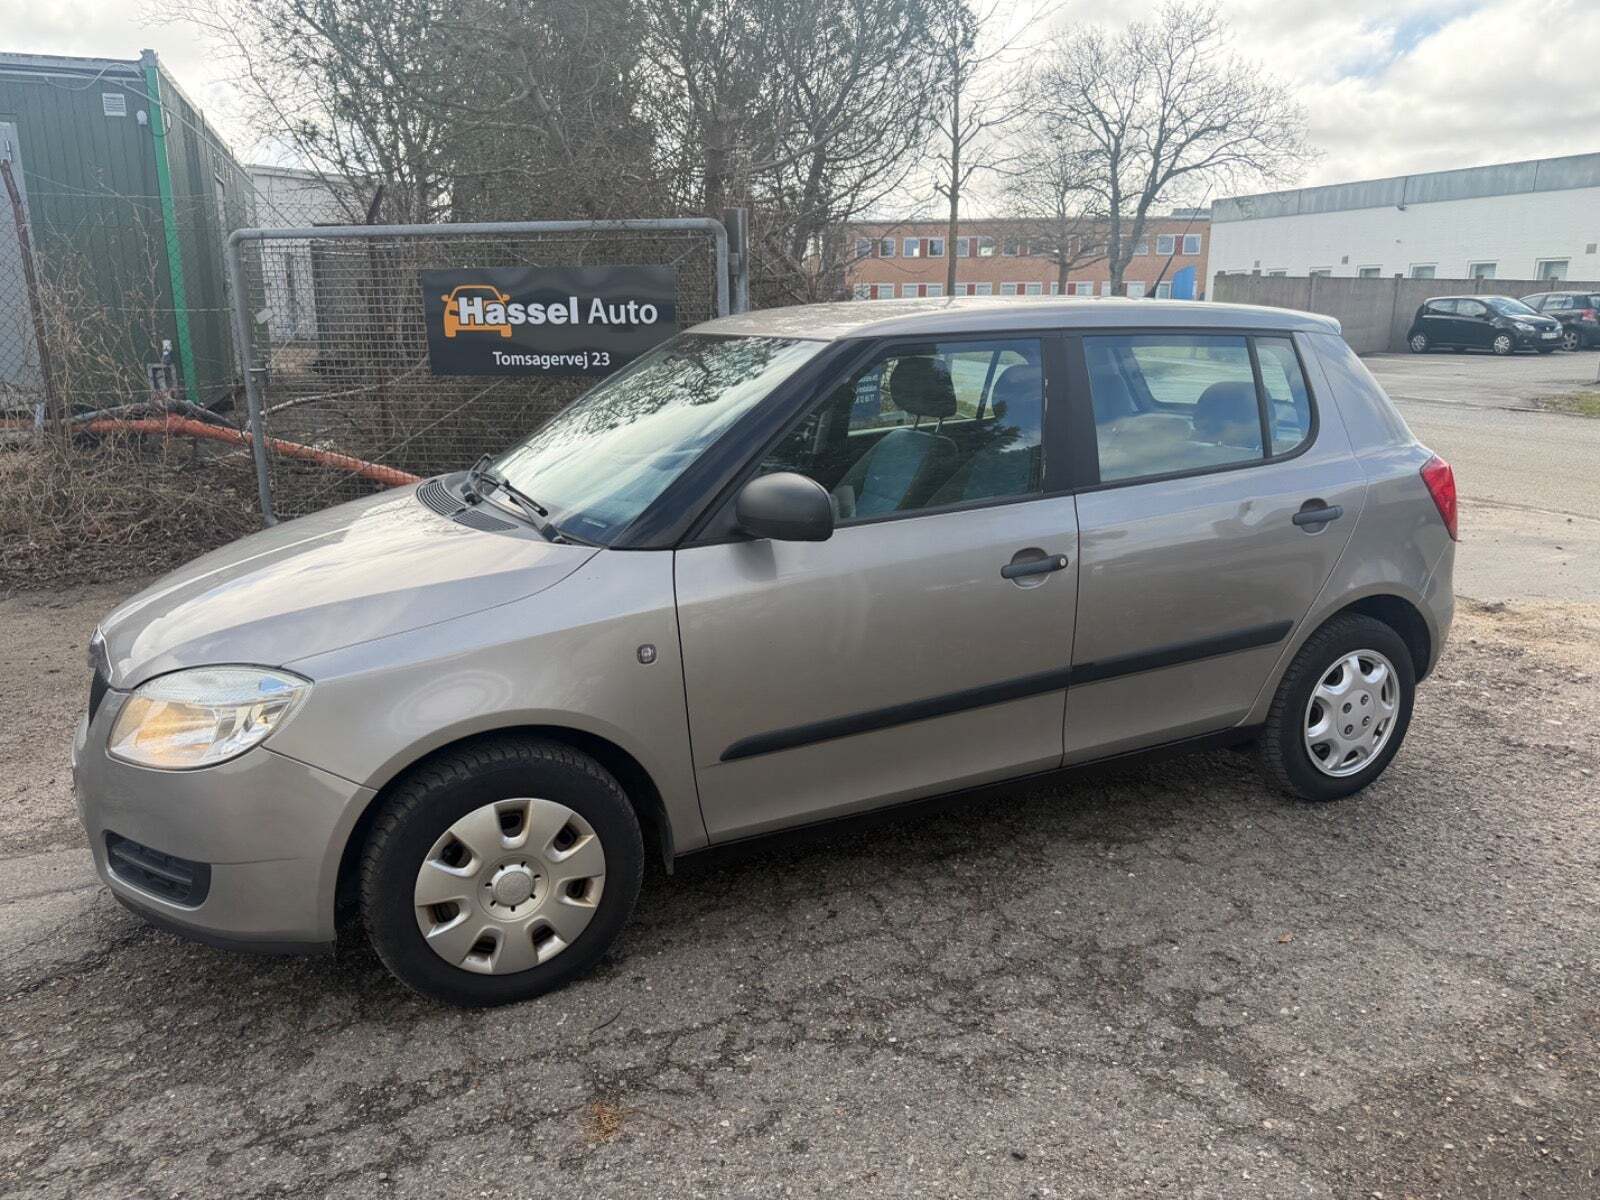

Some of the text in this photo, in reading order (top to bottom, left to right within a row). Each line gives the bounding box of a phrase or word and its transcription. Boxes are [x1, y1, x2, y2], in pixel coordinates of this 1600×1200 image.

[457, 296, 658, 325] Hassel Auto
[493, 351, 611, 369] Tomsagervej 23
